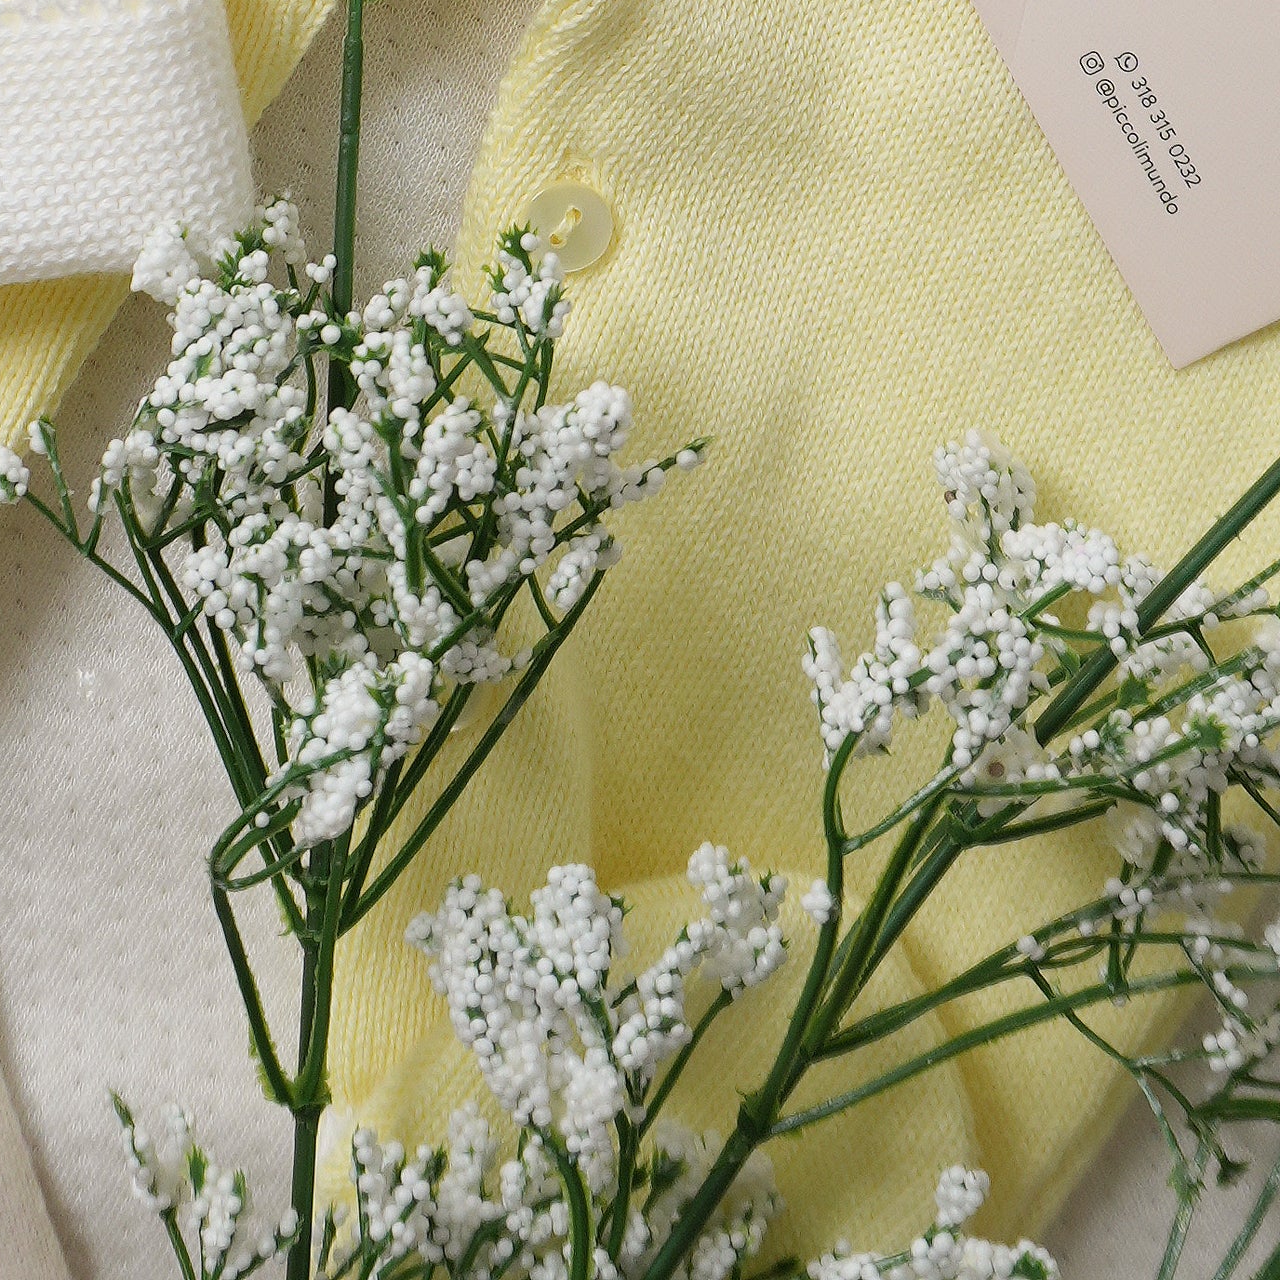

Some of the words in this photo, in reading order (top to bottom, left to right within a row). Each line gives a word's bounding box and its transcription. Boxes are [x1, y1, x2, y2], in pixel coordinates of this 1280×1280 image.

[1095, 78, 1179, 215] @piccolimundo
[1131, 76, 1158, 109] 318
[1150, 109, 1177, 141] 315
[1168, 143, 1202, 189] 0232
